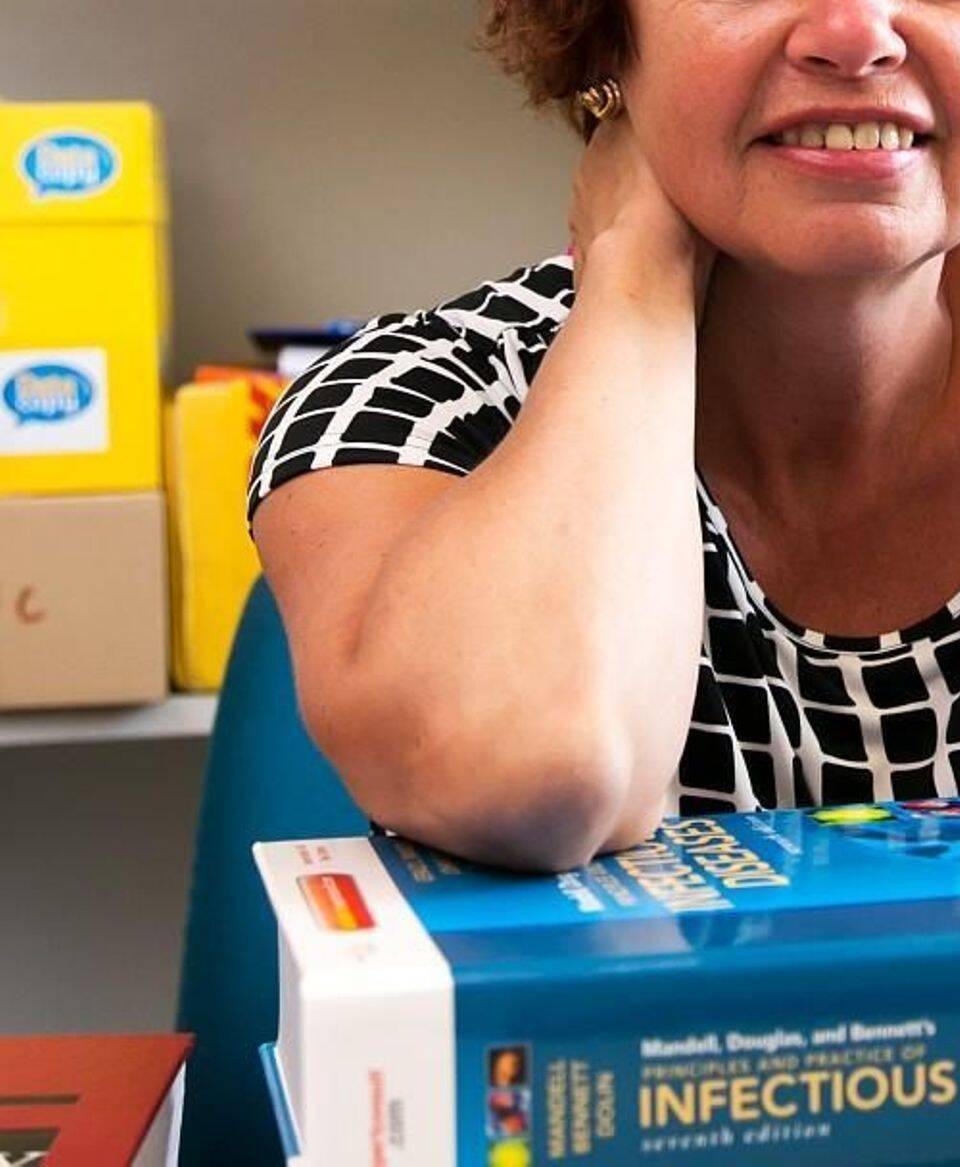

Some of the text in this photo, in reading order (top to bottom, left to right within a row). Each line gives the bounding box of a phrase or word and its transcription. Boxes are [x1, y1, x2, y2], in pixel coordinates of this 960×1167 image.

[811, 1022, 847, 1045] and
[758, 1054, 800, 1072] AND
[900, 1043, 926, 1061] OF
[639, 1060, 957, 1129] INFECTIOUS
